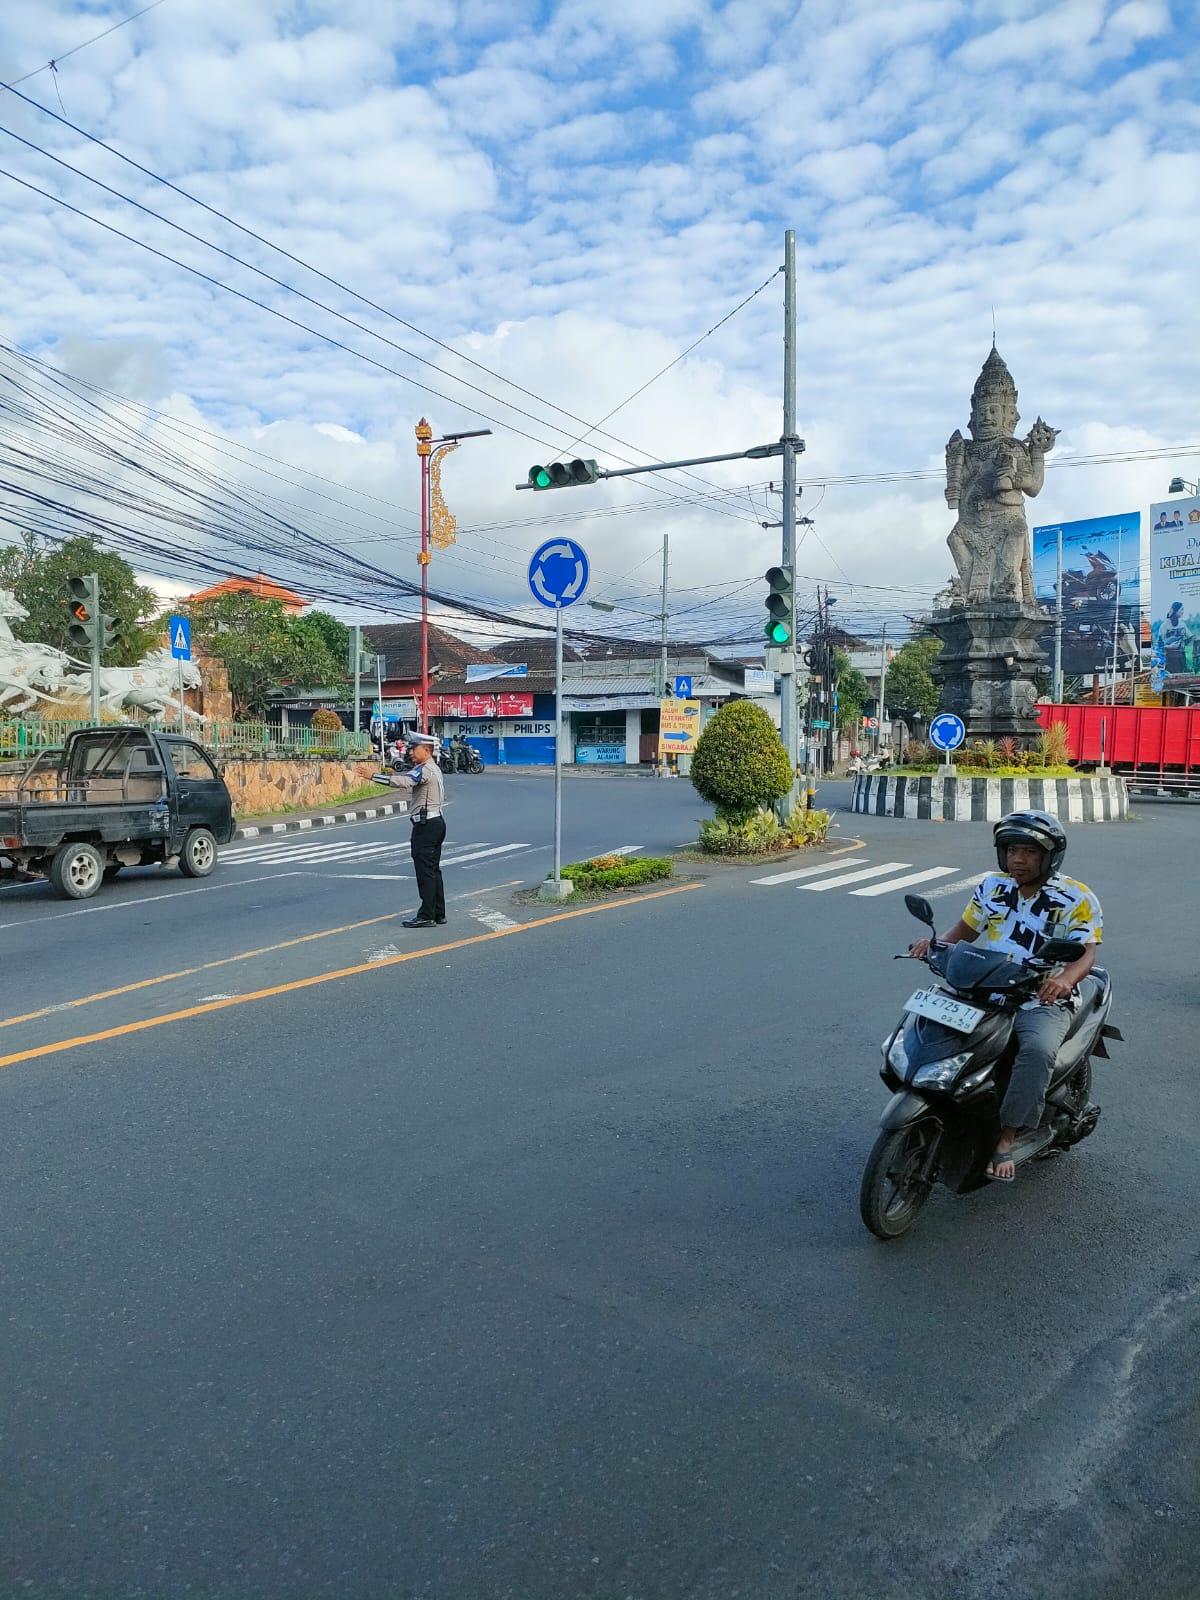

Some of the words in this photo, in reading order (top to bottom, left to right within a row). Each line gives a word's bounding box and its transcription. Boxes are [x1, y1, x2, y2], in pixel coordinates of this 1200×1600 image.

[1160, 553, 1194, 569] KOTA
[514, 723, 551, 734] PHILIPS
[914, 991, 930, 1003] DK
[932, 998, 961, 1013] 4725
